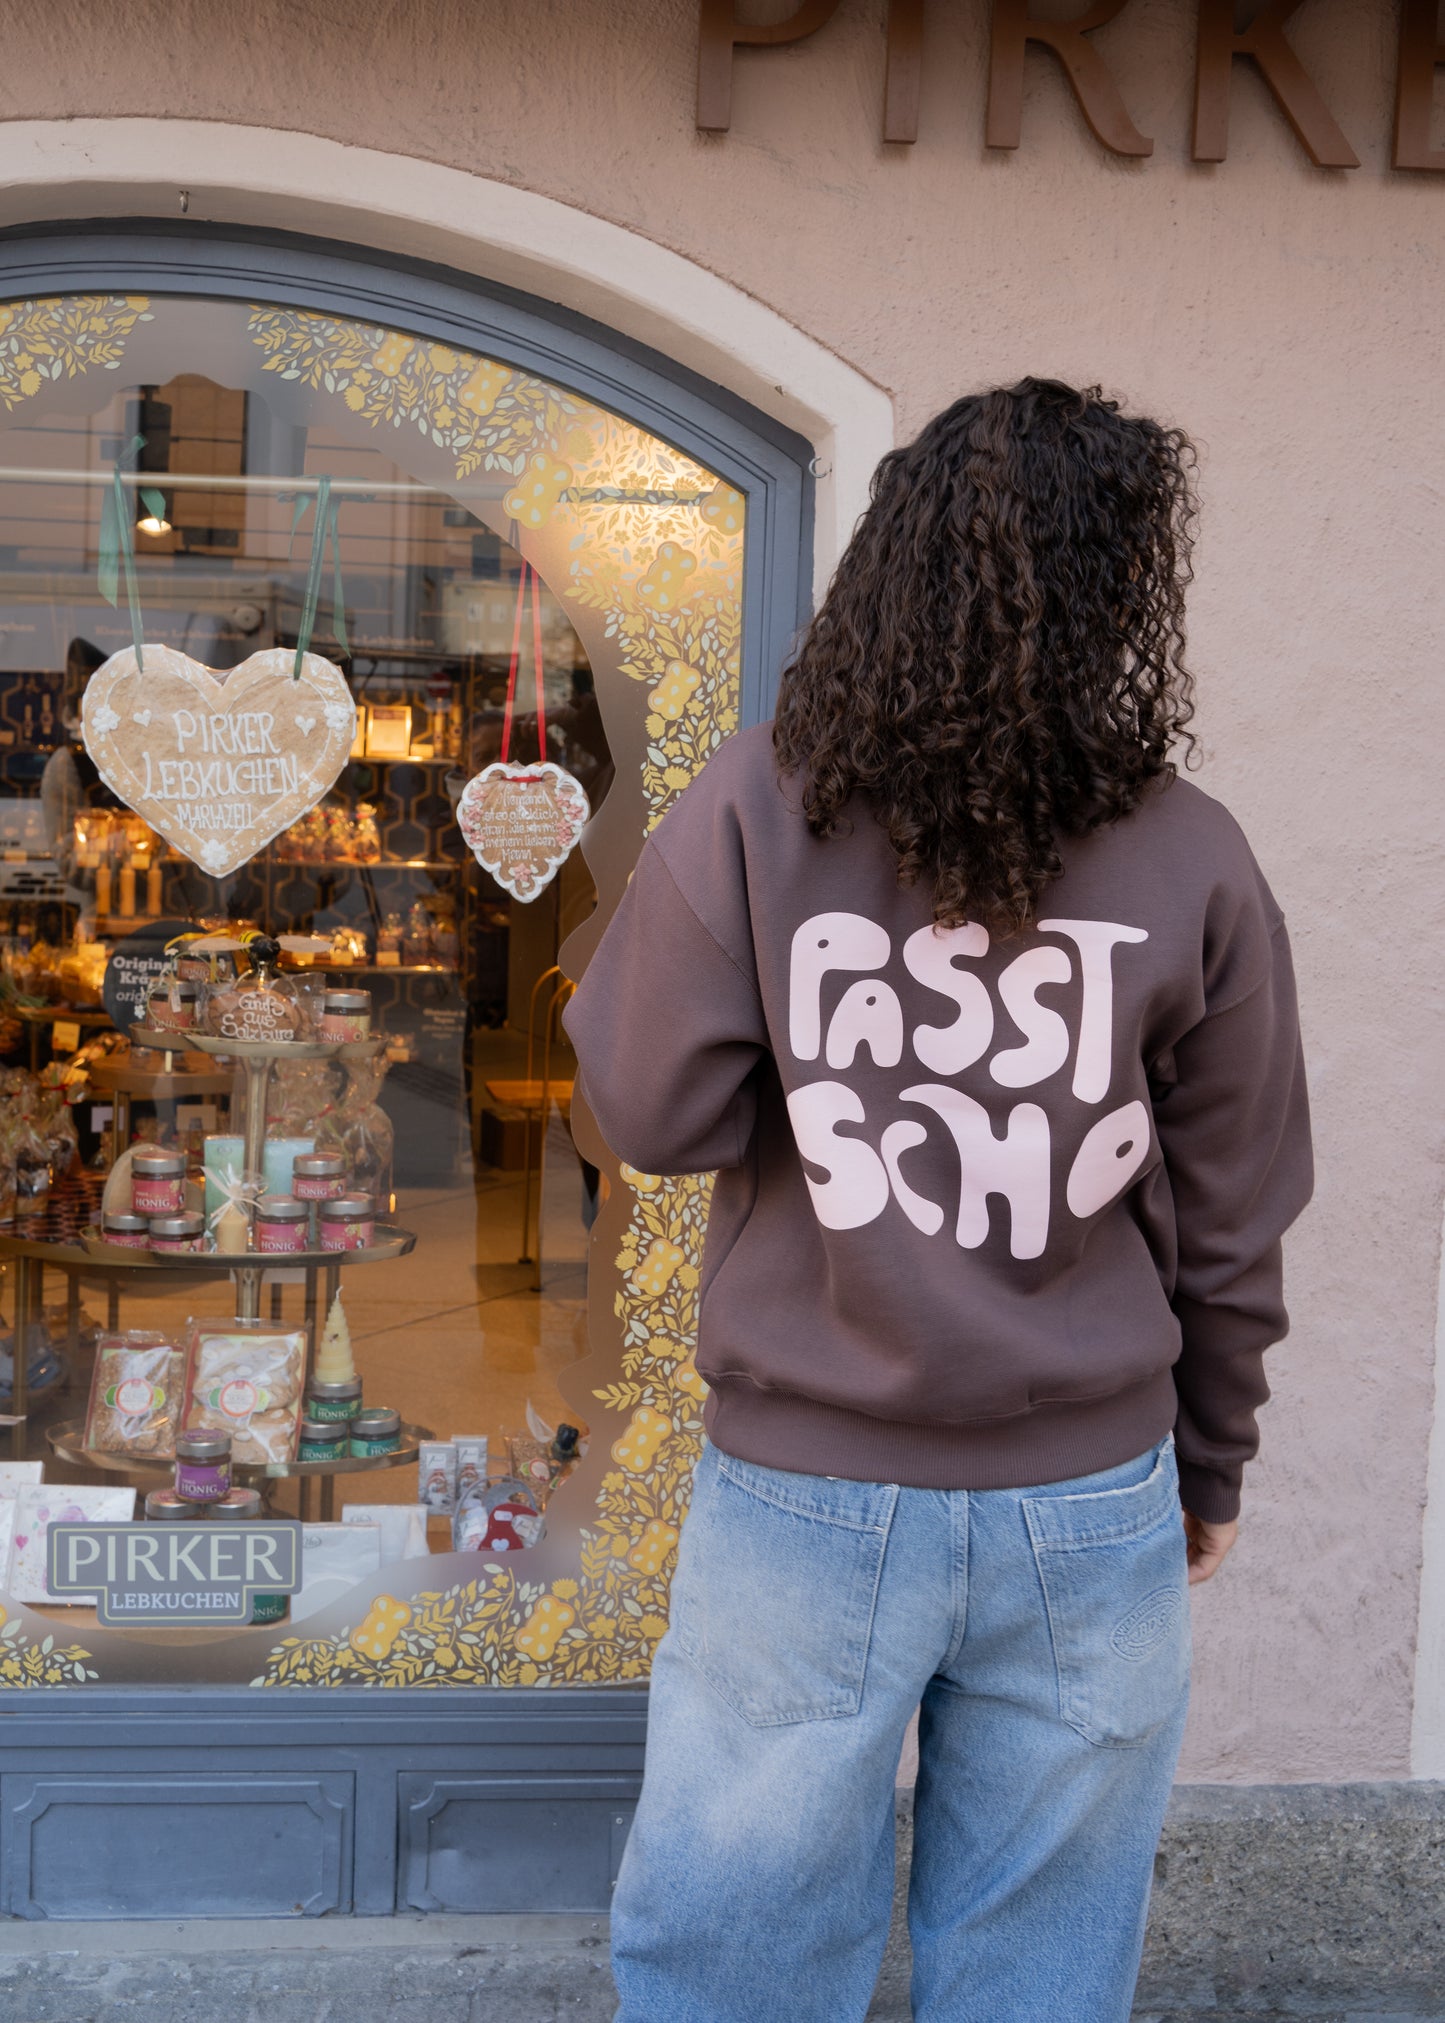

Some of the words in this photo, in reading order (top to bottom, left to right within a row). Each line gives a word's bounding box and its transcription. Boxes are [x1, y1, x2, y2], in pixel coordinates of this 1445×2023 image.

[173, 709, 281, 754] PIRKER
[141, 751, 299, 801] LEBKUCHEN
[176, 802, 255, 831] MARIAZELL
[112, 956, 178, 973] Originl
[297, 1186, 328, 1196] HONIG
[135, 1198, 171, 1208] HONIG
[261, 1240, 296, 1251] HONIG
[320, 1240, 346, 1250] ONIG
[317, 1409, 349, 1418] HONIG
[302, 1448, 333, 1459] HONIG
[181, 1483, 218, 1494] HONIG
[68, 1534, 283, 1582] PIRKER
[111, 1591, 240, 1609] LEBKUCHEN
